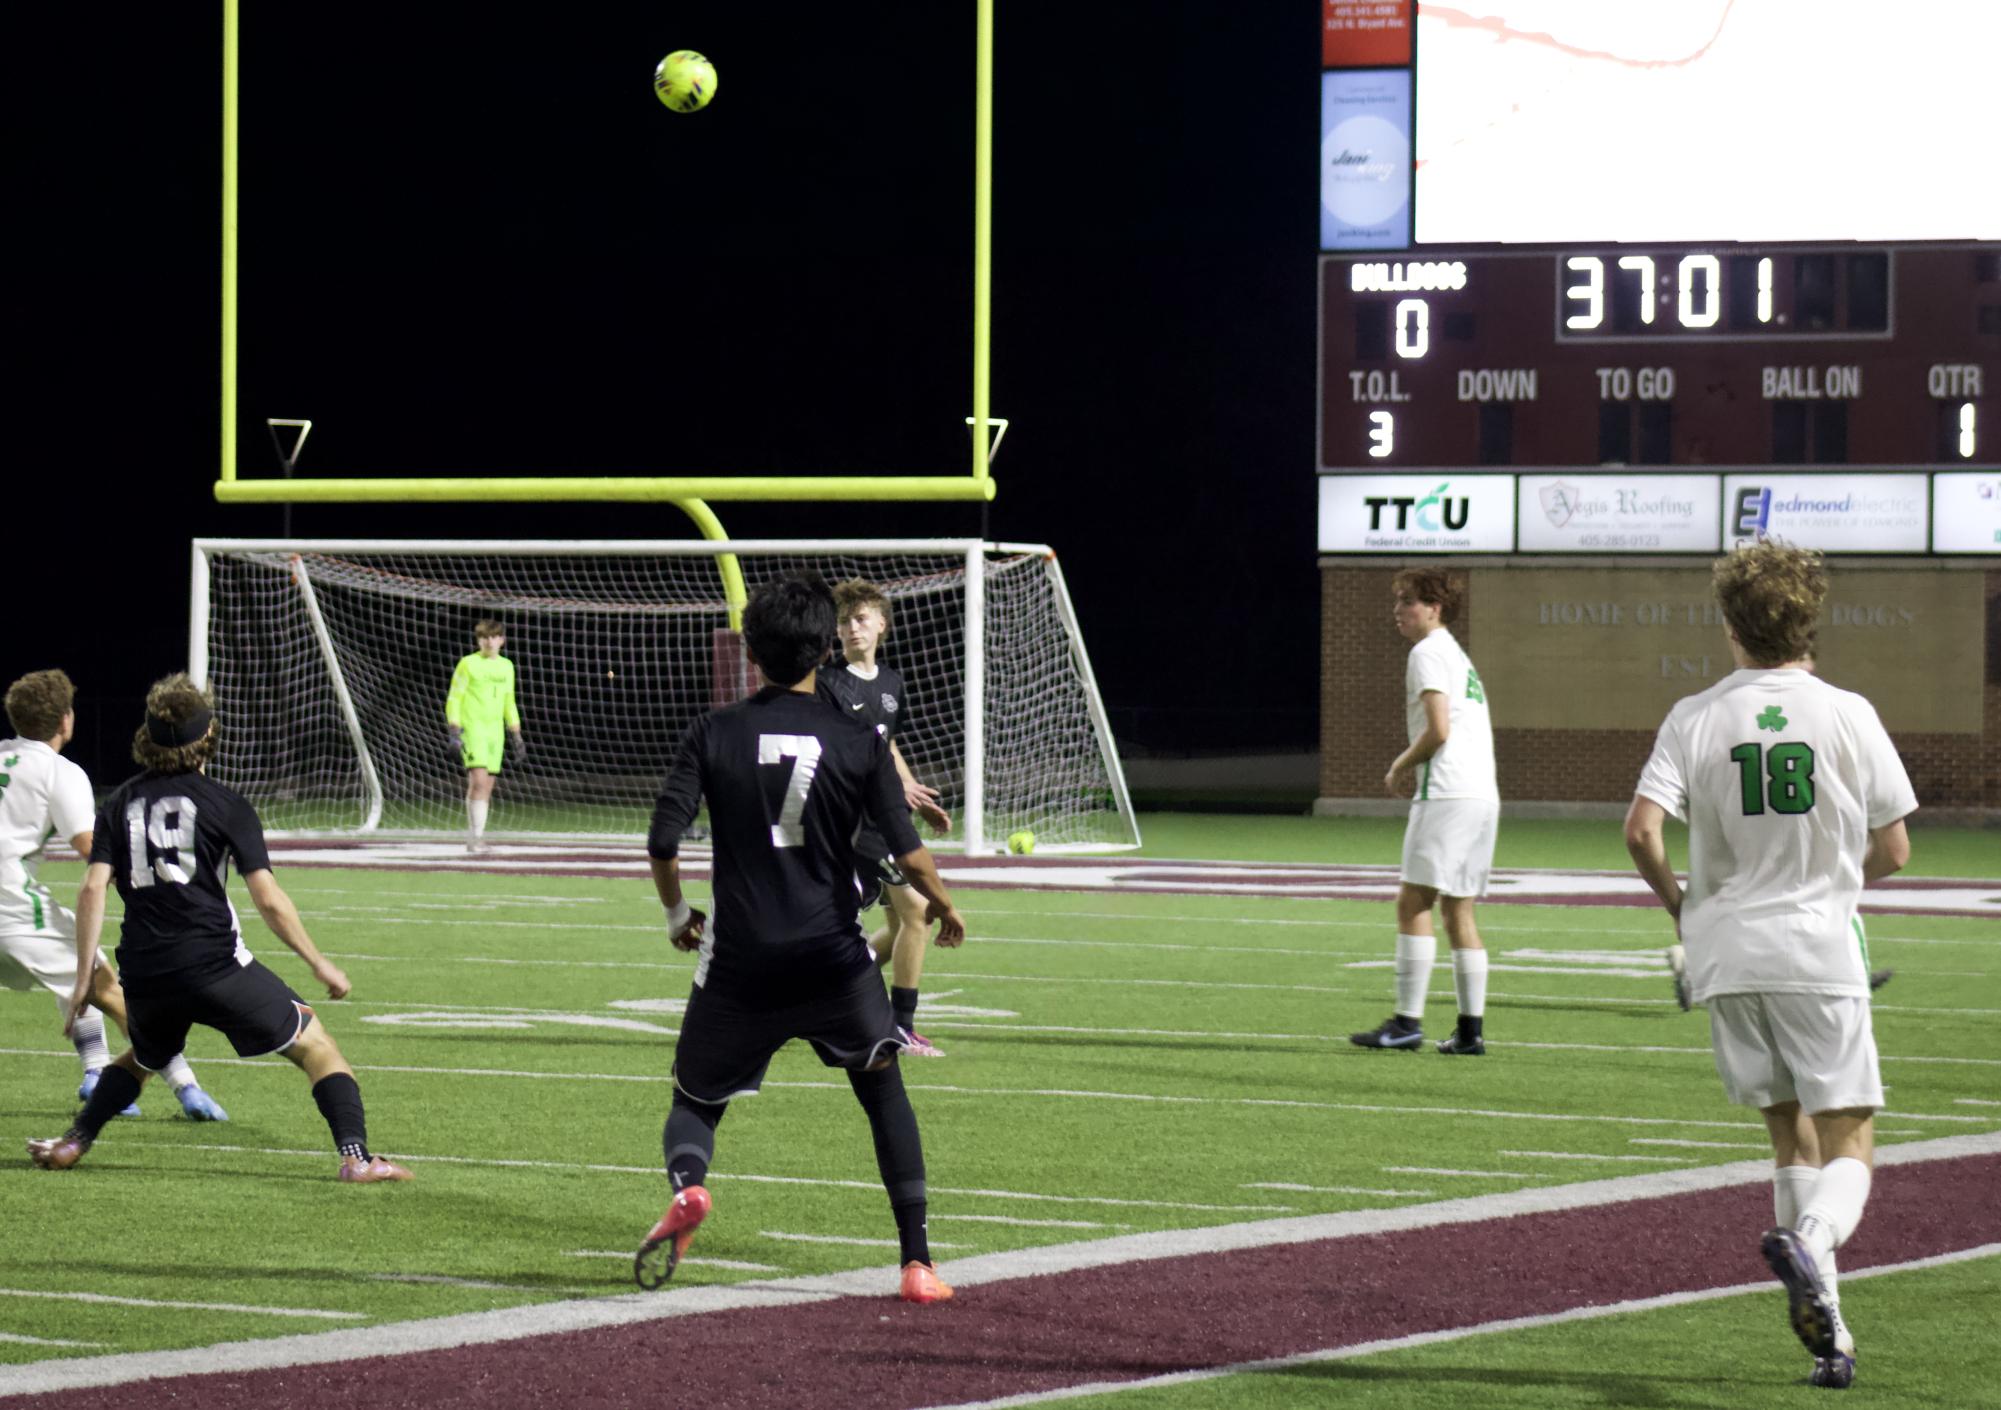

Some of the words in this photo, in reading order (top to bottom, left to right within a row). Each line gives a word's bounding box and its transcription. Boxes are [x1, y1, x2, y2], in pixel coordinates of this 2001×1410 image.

[1395, 299, 1429, 359] 0
[1350, 370, 1412, 402] T.O.L.
[1457, 369, 1537, 401] DOWN
[1596, 368, 1631, 400] TO
[1636, 367, 1675, 400] GO
[1761, 365, 1820, 399] BALL
[1825, 364, 1860, 399] ON
[1928, 363, 1983, 397] QTR
[1368, 410, 1394, 458] 3
[1959, 402, 1976, 458] 1
[1363, 495, 1471, 531] TTCU
[1549, 488, 1608, 518] Aegis
[1614, 488, 1694, 517] Roofing
[1364, 536, 1402, 547] Federal
[1404, 536, 1436, 547] Credit
[1439, 536, 1471, 547] Union
[1538, 602, 1624, 626] HOME
[1636, 602, 1671, 626] OF
[757, 733, 822, 848] 7
[1730, 741, 1815, 816] 18
[126, 796, 198, 889] 19
